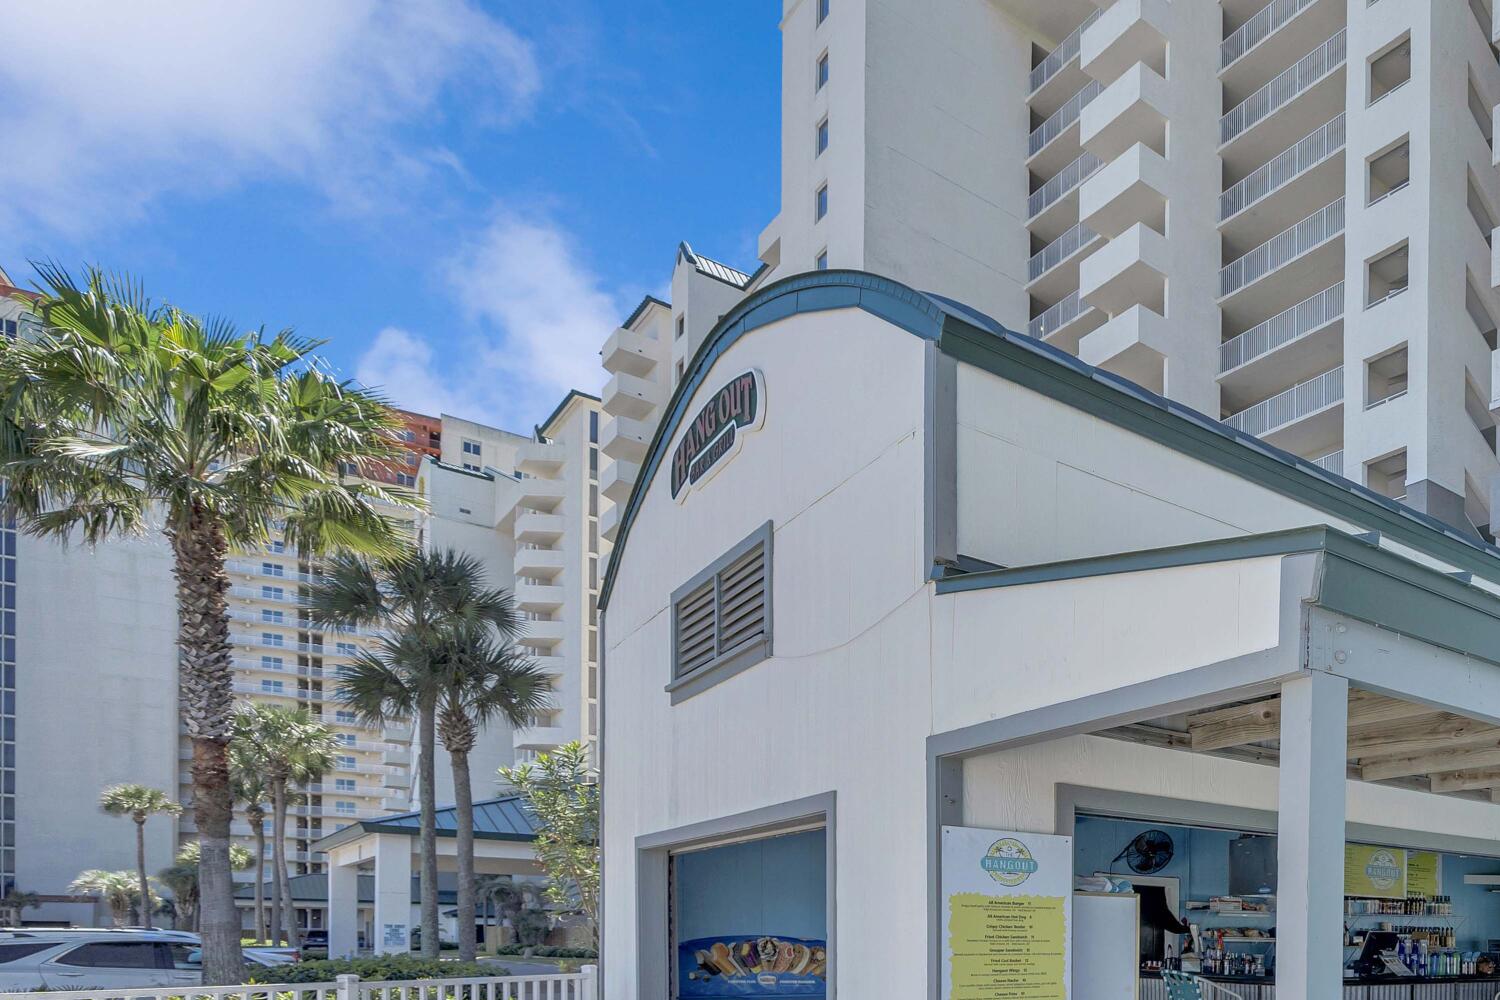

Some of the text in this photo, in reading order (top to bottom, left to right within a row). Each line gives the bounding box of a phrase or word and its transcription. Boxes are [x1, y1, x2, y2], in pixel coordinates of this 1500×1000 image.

[674, 376, 752, 489] HANG OUT
[985, 858, 1035, 871] HANGOUT
